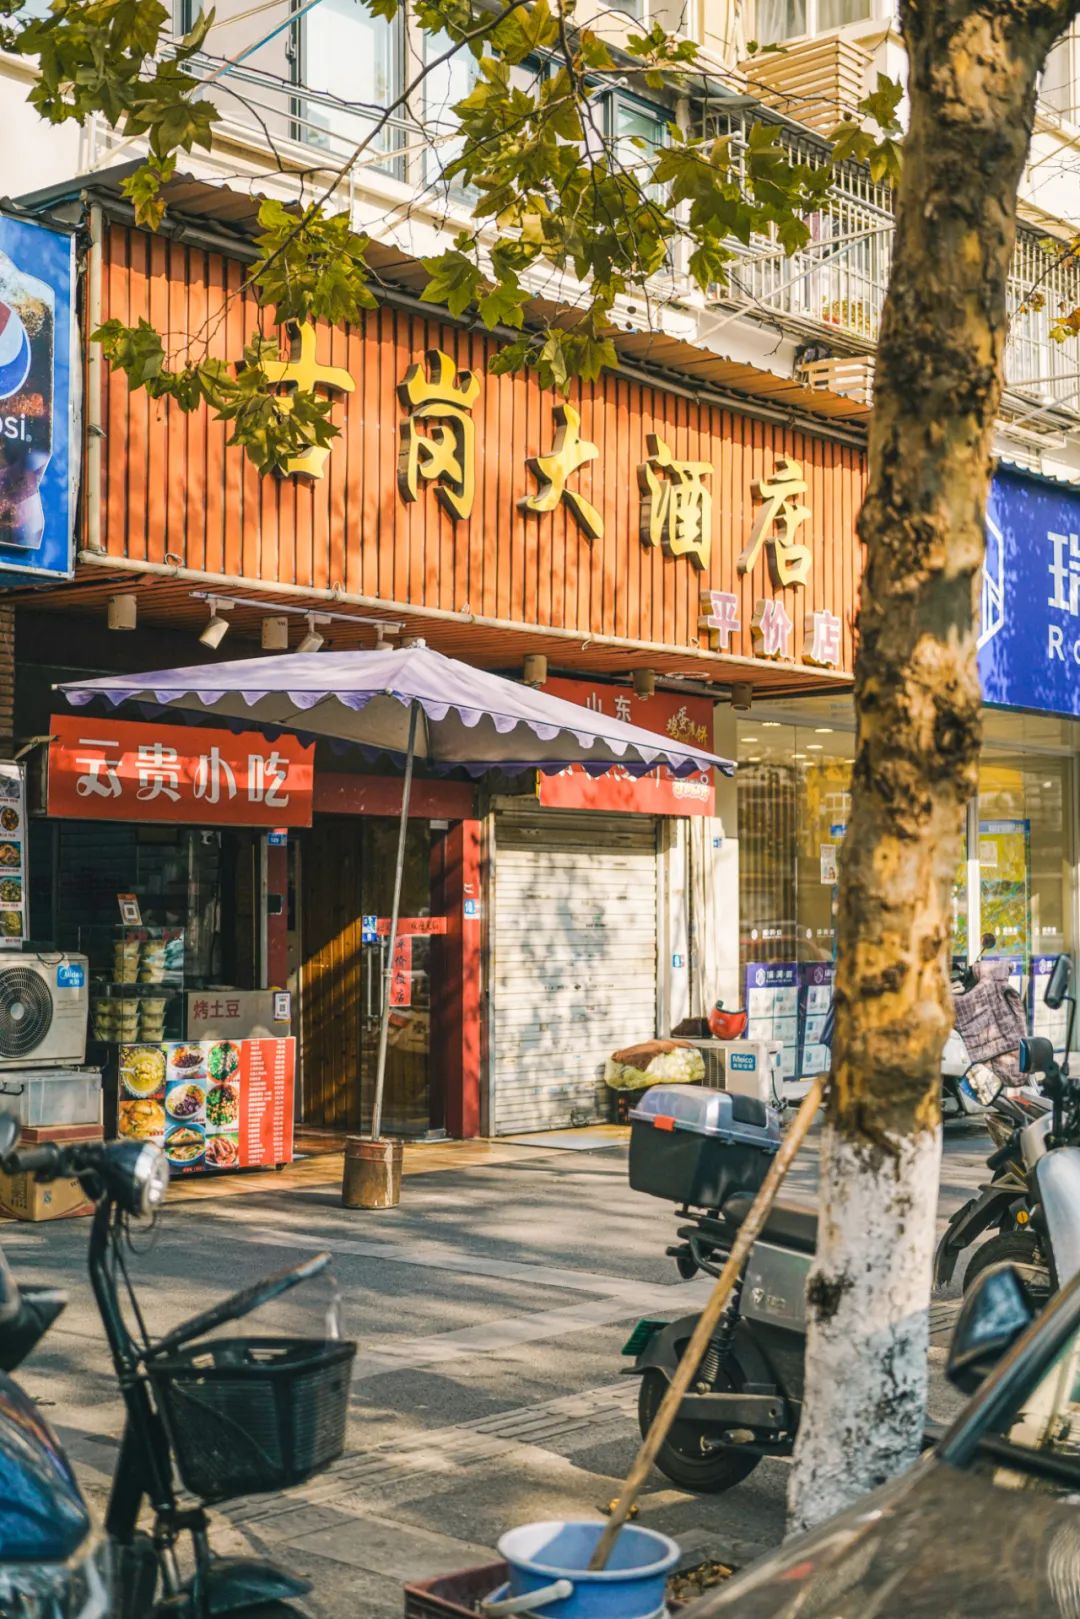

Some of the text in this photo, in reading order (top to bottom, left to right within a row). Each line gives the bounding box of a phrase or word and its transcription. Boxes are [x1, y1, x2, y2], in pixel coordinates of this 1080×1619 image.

[0, 412, 26, 441] si
[699, 590, 841, 666] 平价店
[75, 738, 290, 808] 云贵小吃
[193, 999, 241, 1020] 烤土豆
